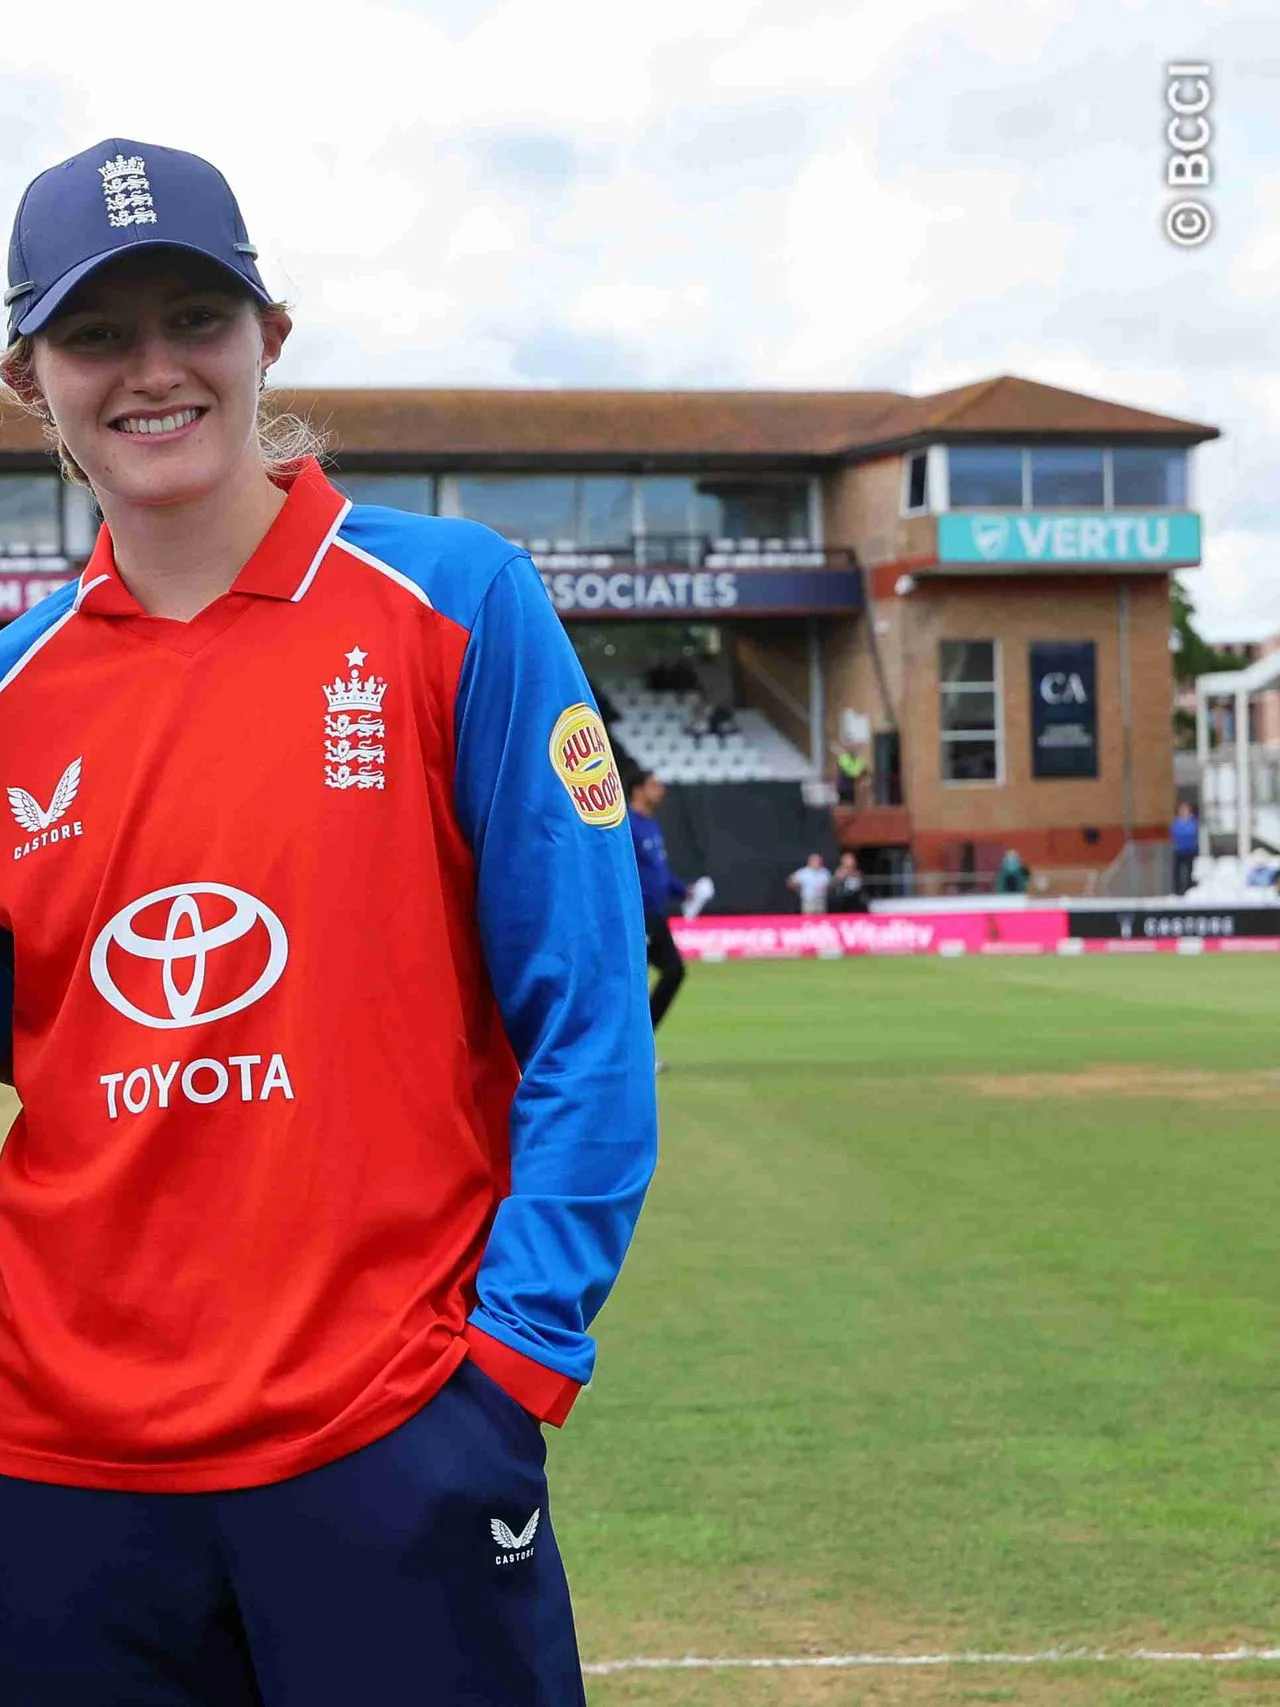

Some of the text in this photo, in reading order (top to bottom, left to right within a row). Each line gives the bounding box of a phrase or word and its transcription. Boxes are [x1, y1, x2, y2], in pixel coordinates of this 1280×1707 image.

[1017, 515, 1171, 560] VERTU
[544, 573, 739, 609] SOCIATES
[1040, 671, 1087, 705] CA
[561, 726, 606, 773] HULA
[13, 820, 84, 860] CASTORE
[99, 1053, 295, 1119] TOYOTA
[495, 1547, 535, 1565] CASTORE
